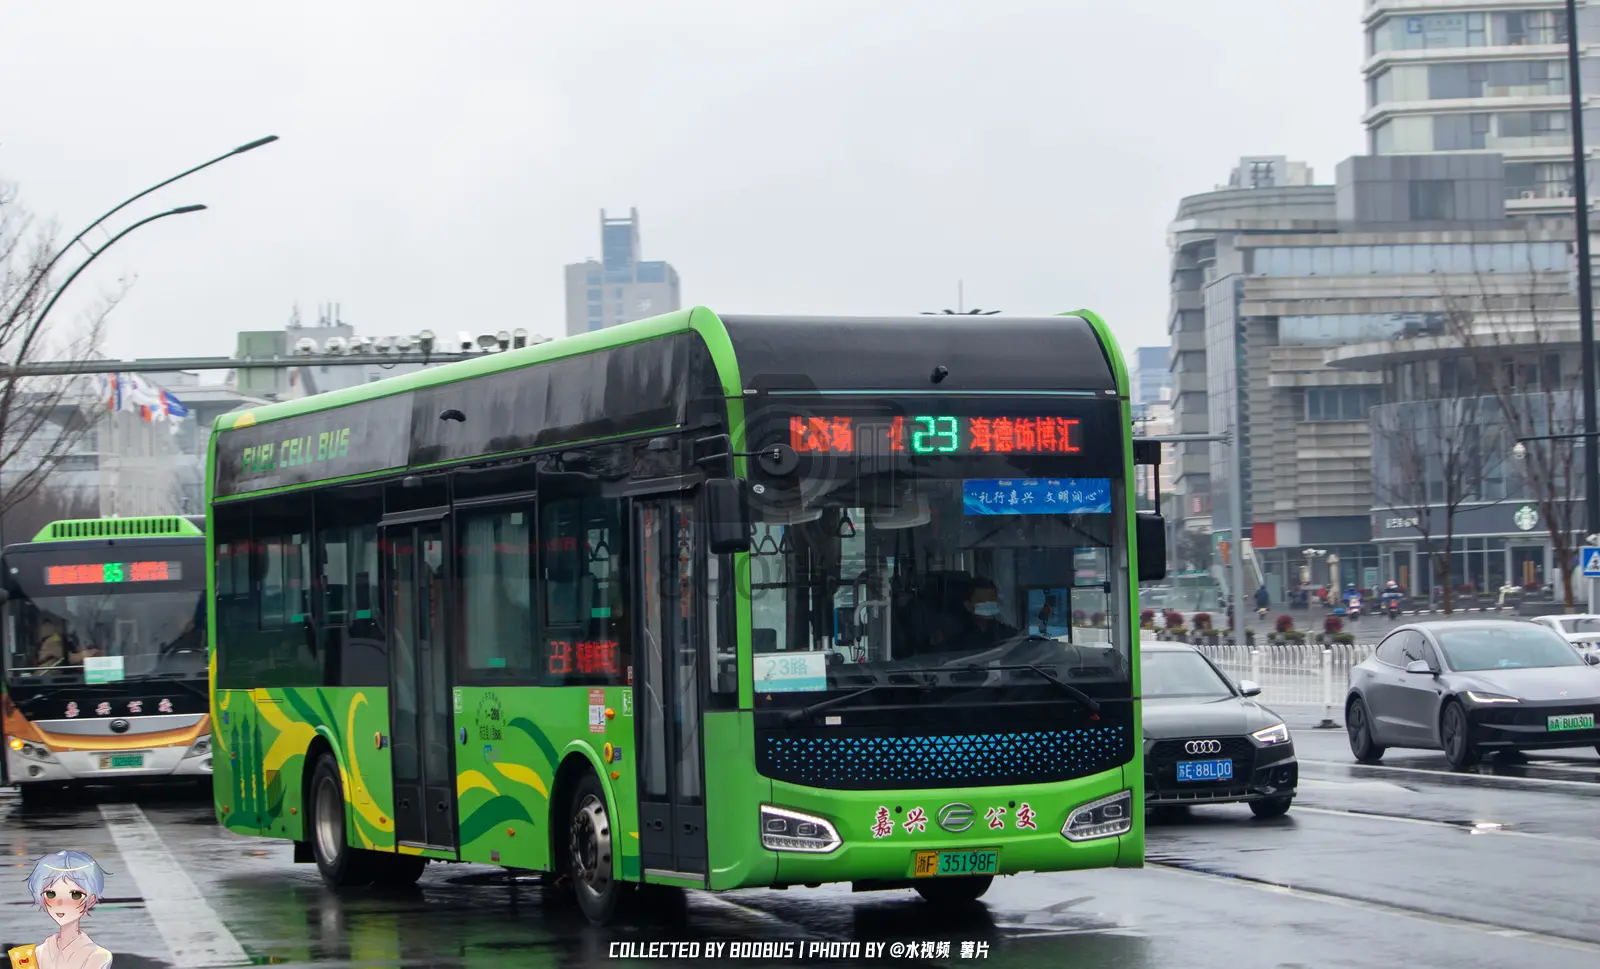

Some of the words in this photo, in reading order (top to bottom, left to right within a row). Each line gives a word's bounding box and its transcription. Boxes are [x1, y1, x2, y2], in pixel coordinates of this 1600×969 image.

[242, 443, 276, 474] FUEL
[280, 435, 313, 467] CELL
[318, 427, 350, 461] BUS
[913, 415, 959, 452] 23
[969, 416, 1081, 452] 海德饰博汇
[766, 658, 808, 676] 23路
[870, 806, 928, 839] 嘉兴
[984, 802, 1037, 830] 公交
[942, 853, 996, 872] 35198F
